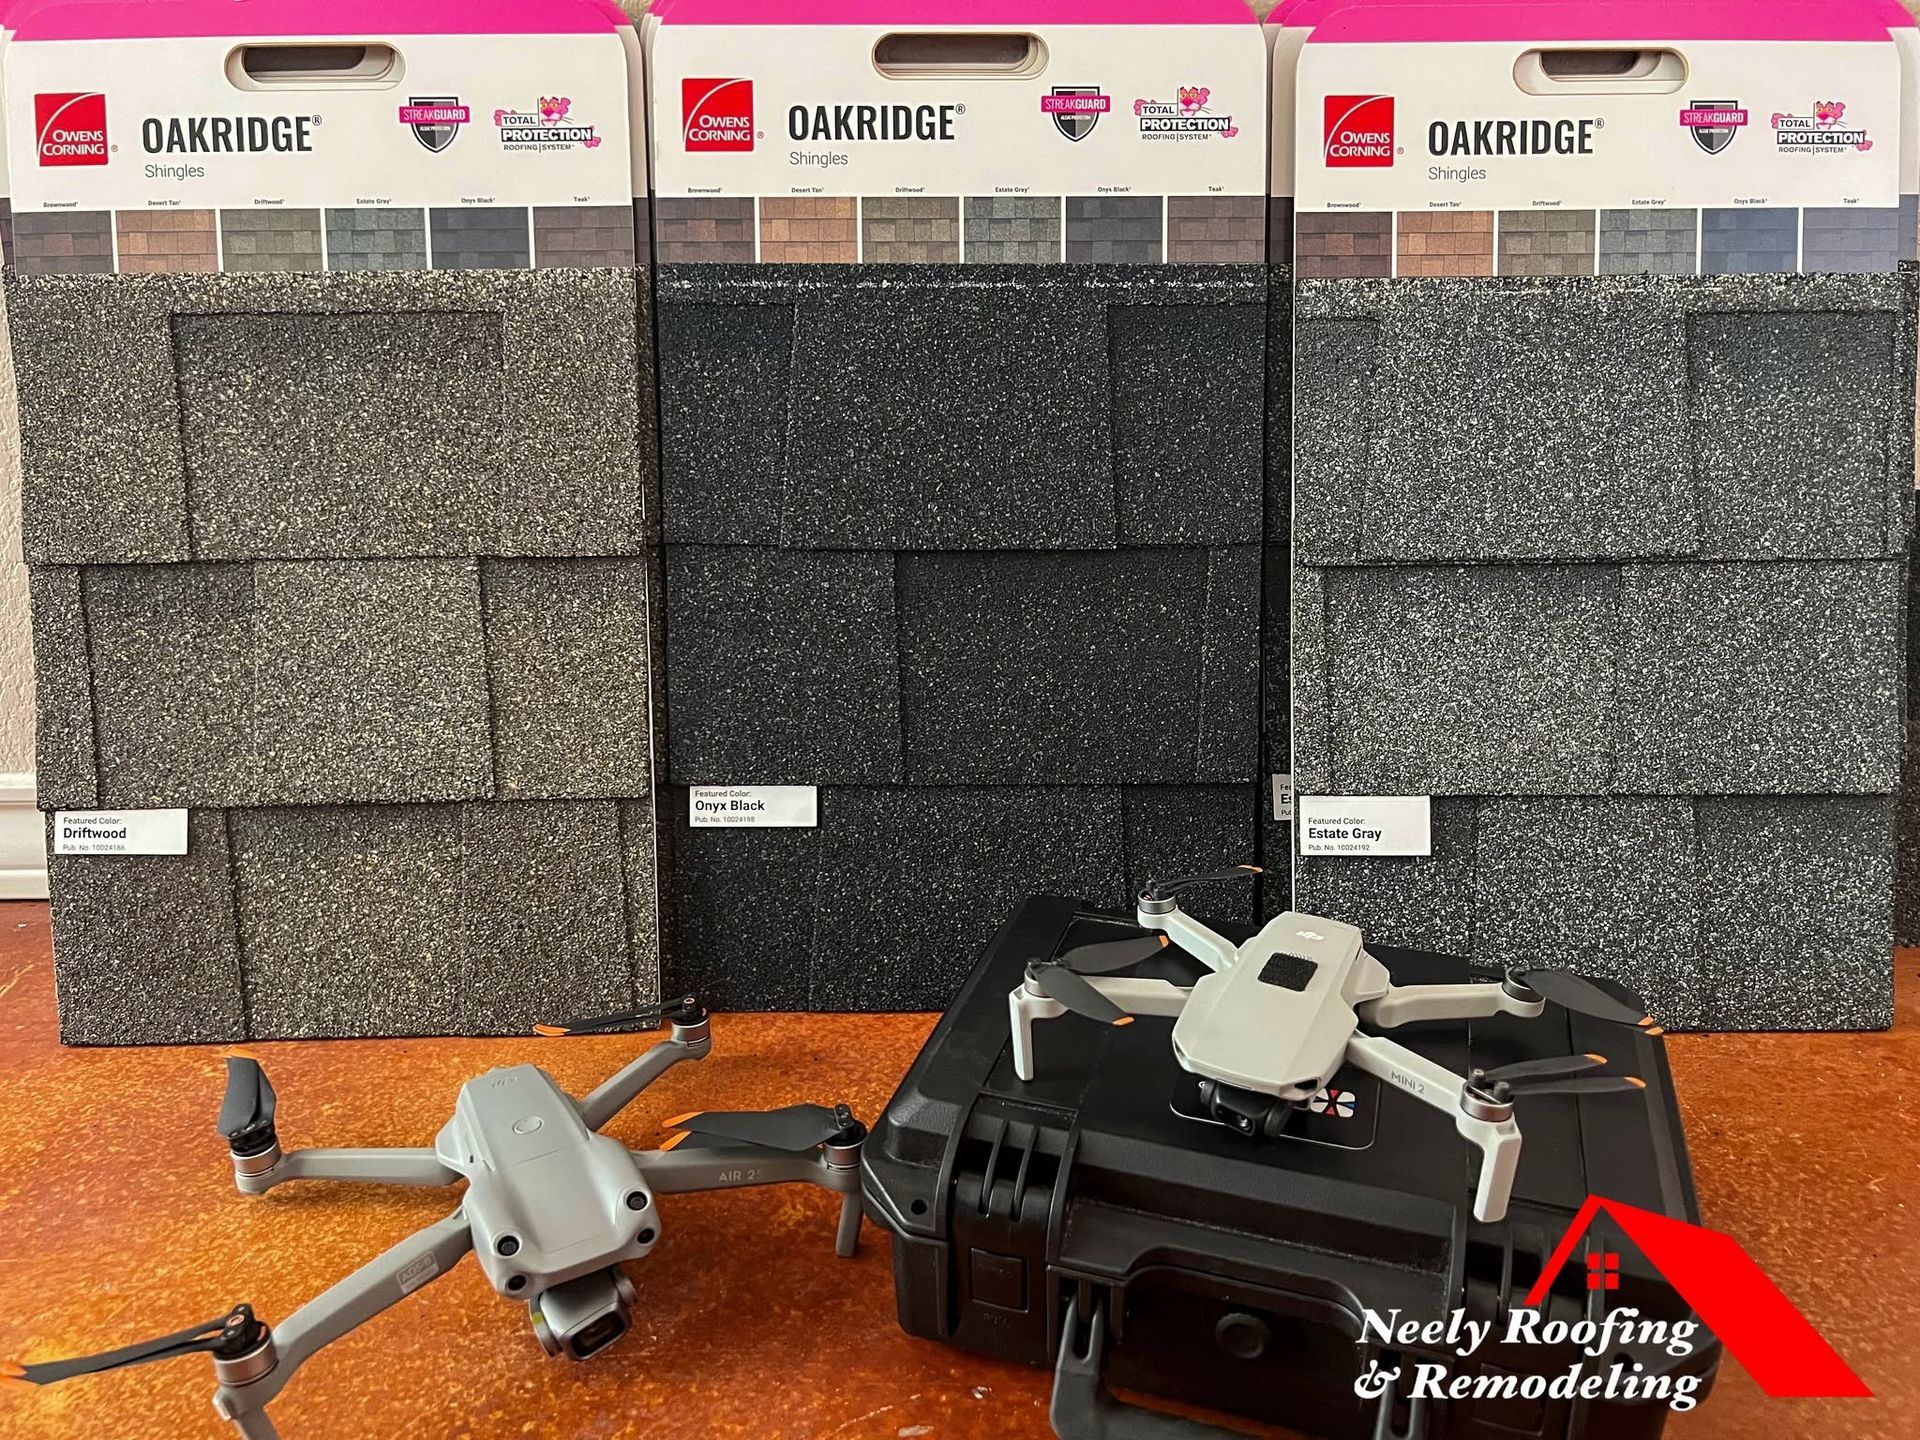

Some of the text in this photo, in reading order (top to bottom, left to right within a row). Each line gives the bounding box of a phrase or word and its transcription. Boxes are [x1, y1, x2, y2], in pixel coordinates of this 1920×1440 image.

[1045, 98, 1106, 110] STREAKGUARD
[1142, 105, 1175, 114] TOTAL
[403, 109, 466, 121] STREAKGUARD
[503, 116, 536, 125] TOTAL
[1683, 112, 1744, 123] STREAKGUARD
[699, 116, 750, 128] OWENS
[1141, 118, 1229, 130] PROTECTION
[1779, 119, 1811, 128] TOTAL
[53, 129, 104, 141] OWENS
[502, 128, 592, 141] PROTECTION
[688, 129, 750, 142] CORNING
[1340, 131, 1391, 144] OWENS
[1778, 132, 1864, 144] PROTECTION
[43, 143, 105, 155] CORNING
[1330, 145, 1391, 157] CORNING
[789, 151, 849, 168] Shingles
[145, 164, 205, 181] Shingles
[1428, 166, 1486, 183] Shingles
[729, 789, 752, 797] Color:
[695, 799, 765, 813] Onyx Black
[63, 817, 122, 825] Featured Color:
[1308, 817, 1366, 825] Featured Color:
[63, 827, 127, 839] Driftwood
[1308, 827, 1382, 842] Estate Gray
[1391, 1070, 1425, 1094] MINI 2
[718, 1170, 742, 1183] AIR
